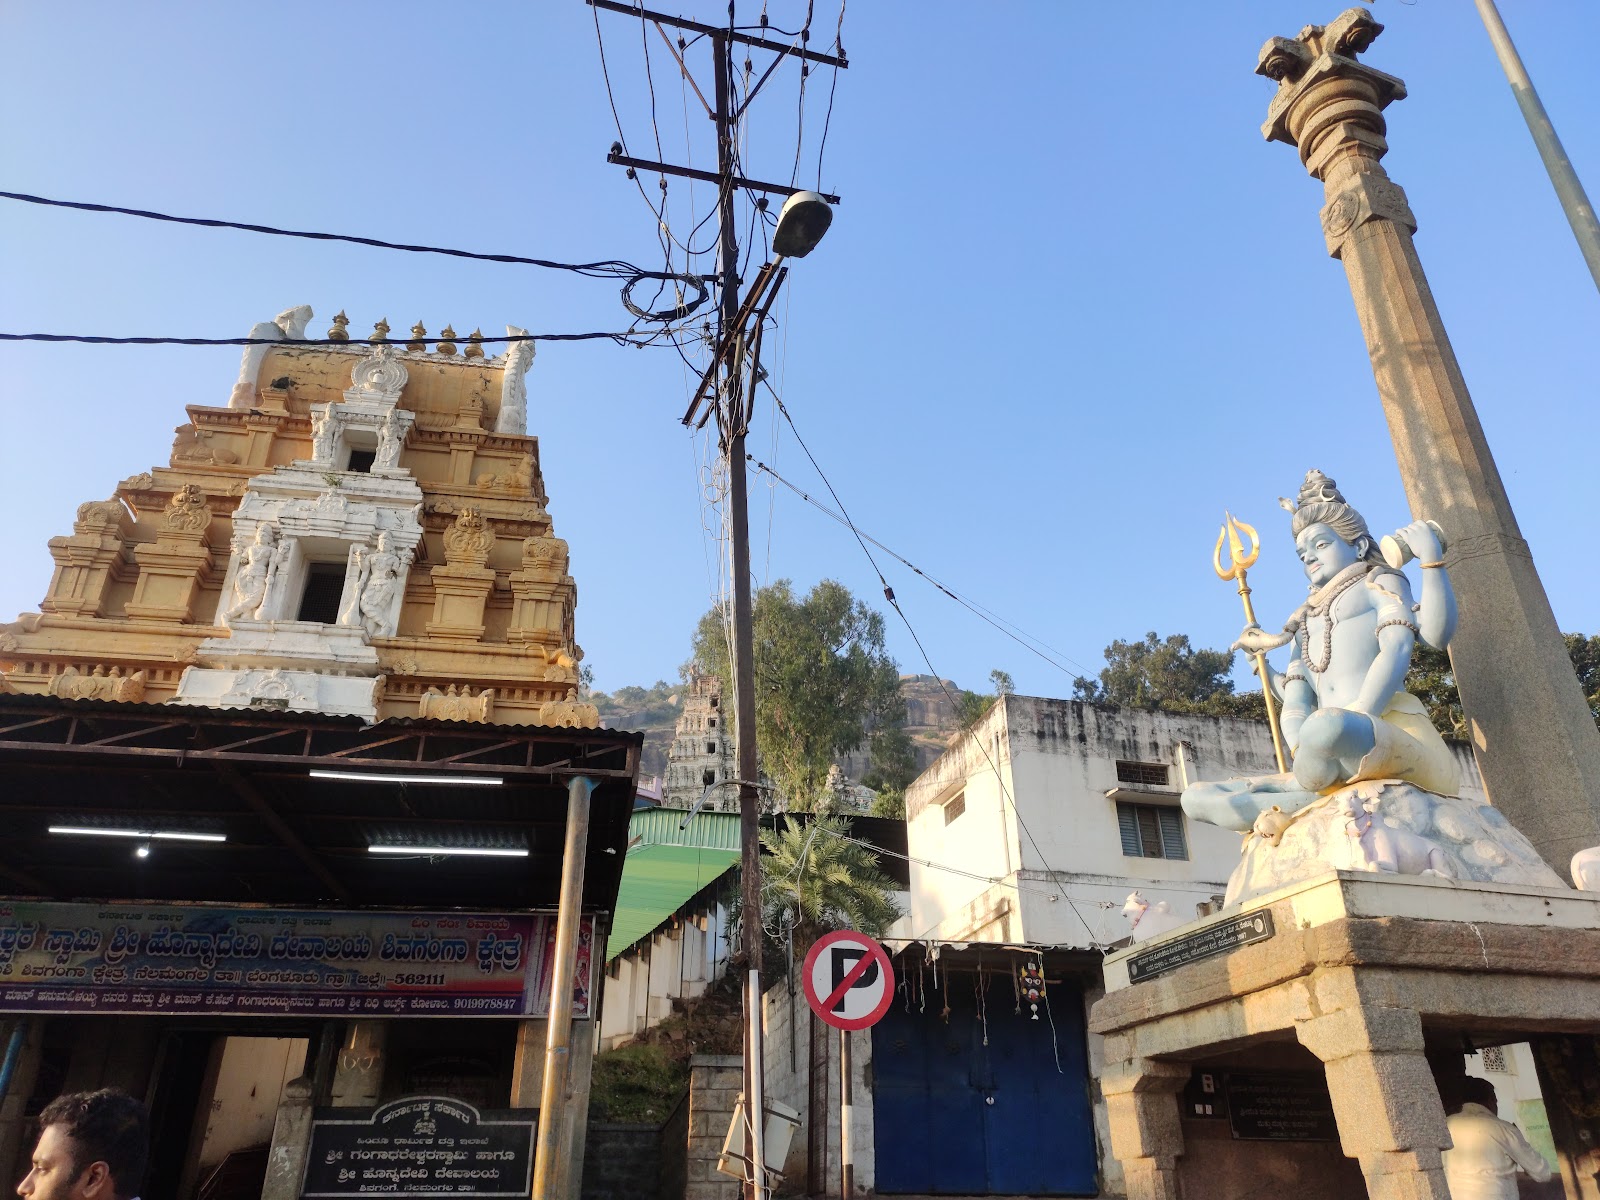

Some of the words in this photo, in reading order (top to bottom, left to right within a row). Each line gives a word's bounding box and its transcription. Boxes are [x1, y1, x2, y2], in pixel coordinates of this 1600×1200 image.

[411, 917, 430, 928] ಓಂ
[466, 918, 510, 930] ಶಿವಾಯ
[43, 927, 103, 965] ಸ್ವಾಮಿ
[105, 925, 141, 964] ಶ್ರೀ
[269, 930, 373, 960] ದೇವಾಲಯ
[380, 933, 469, 962] ಶಿವಗಂಗಾ
[477, 932, 522, 974] ಕ್ಷೇತ್ರ
[21, 964, 87, 978] ಶಿವಗಂಗಾ
[135, 966, 209, 981] ನೆಲಮಂಗಲ
[247, 968, 319, 983] ಬೆಂಗಳೂರು
[831, 947, 879, 1013] P
[131, 991, 155, 1007] ಮತ್ತು
[157, 992, 171, 1007] ಶ್ರೀ
[318, 996, 345, 1008] ಹಾಗೂ
[348, 996, 361, 1011] ಶ್ರೀ
[454, 998, 517, 1009] 9019978847
[382, 1101, 431, 1124] ಕರ್ನಾಟಕ
[434, 1103, 470, 1124] ಸರ್ಕಾರ
[324, 1149, 344, 1165] ಶ್ರೀ
[475, 1149, 516, 1161] ಹಾಗೂ
[337, 1168, 356, 1183] ಶ್ರೀ
[435, 1166, 500, 1179] ದೇವಾಲಯ
[404, 1183, 454, 1192] ನೆಲಮಂಗಲ
